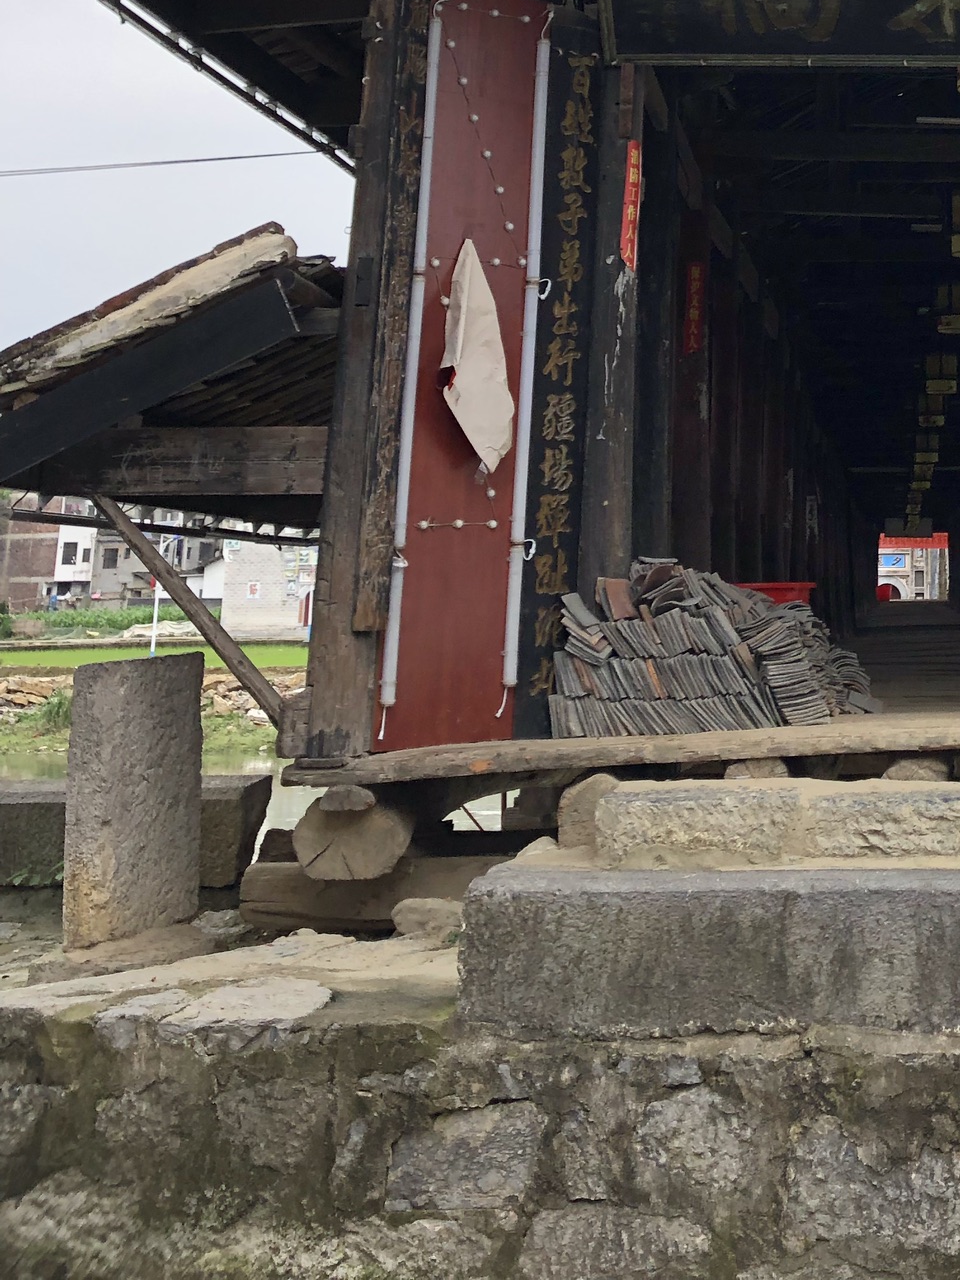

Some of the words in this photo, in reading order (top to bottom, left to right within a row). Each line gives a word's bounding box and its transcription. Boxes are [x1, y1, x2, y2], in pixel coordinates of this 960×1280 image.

[624, 149, 639, 267] 消防工作人人
[687, 266, 701, 353] 保护文物人人
